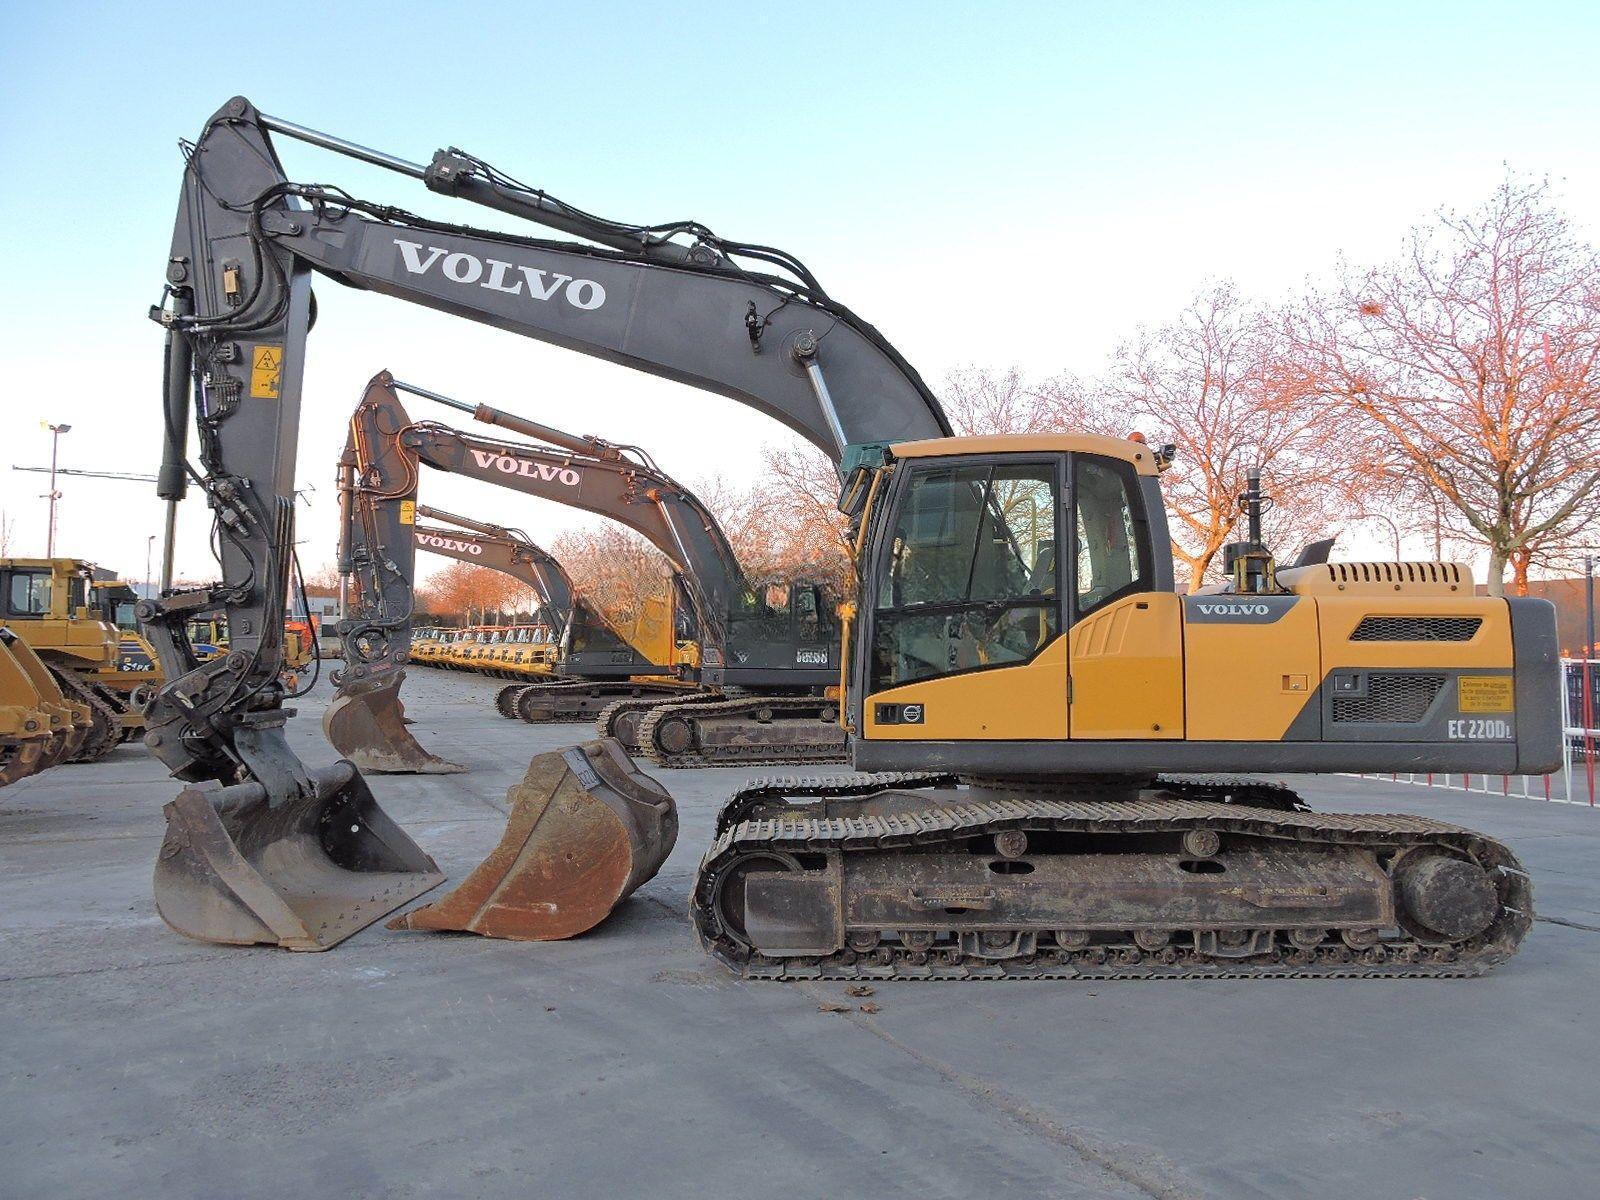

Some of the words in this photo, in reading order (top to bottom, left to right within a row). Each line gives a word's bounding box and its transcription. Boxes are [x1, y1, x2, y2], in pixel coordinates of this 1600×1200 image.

[393, 238, 606, 310] VOLVO
[470, 449, 580, 486] VOLVO
[415, 532, 482, 555] VOLVO
[1197, 604, 1269, 616] VOLVO
